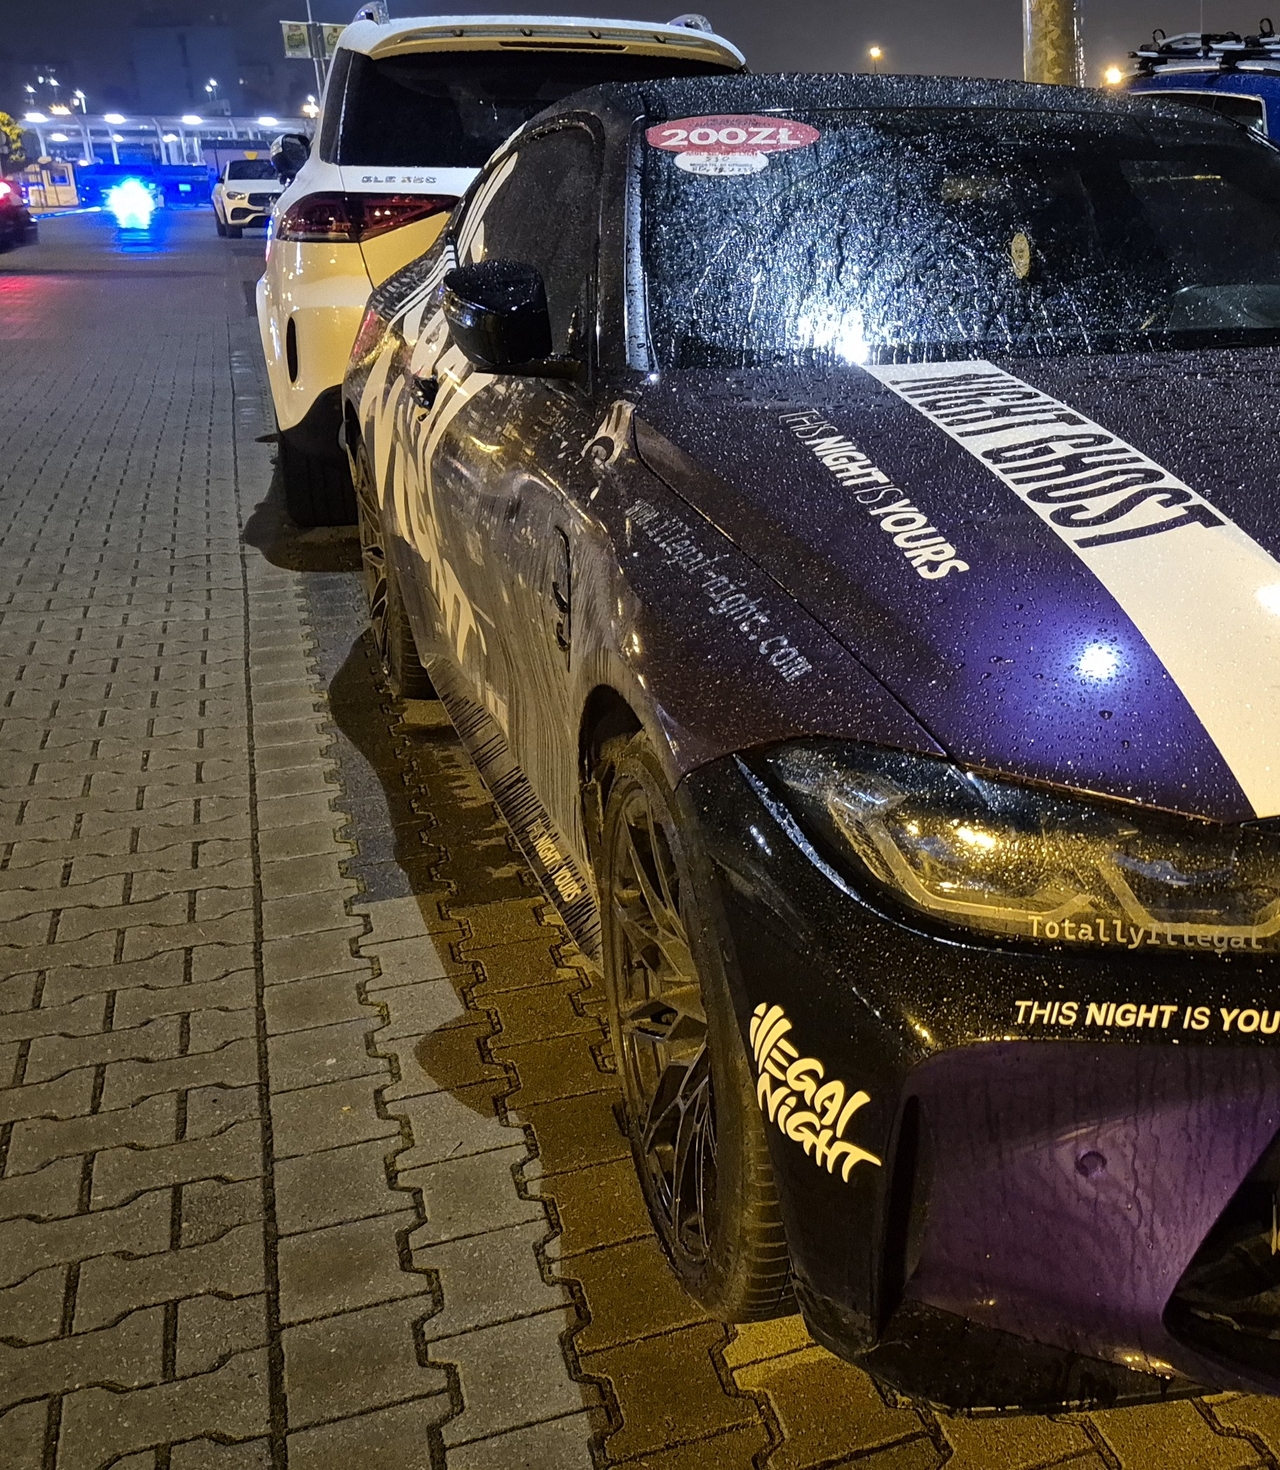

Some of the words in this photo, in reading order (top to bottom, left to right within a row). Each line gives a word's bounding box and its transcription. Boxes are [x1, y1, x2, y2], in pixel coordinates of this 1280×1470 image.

[361, 176, 397, 184] GLE
[778, 409, 838, 440] THIS
[889, 373, 1088, 438] NIGHT
[805, 436, 890, 487] NIGHT
[856, 483, 905, 505] IS
[982, 433, 1227, 549] GHOST
[869, 499, 970, 580] YOURS
[533, 834, 561, 867] NIGHT
[551, 865, 582, 902] YOURS
[1015, 1000, 1079, 1026] THIS
[1085, 1002, 1178, 1029] NIGHT
[1183, 1006, 1211, 1031] IS
